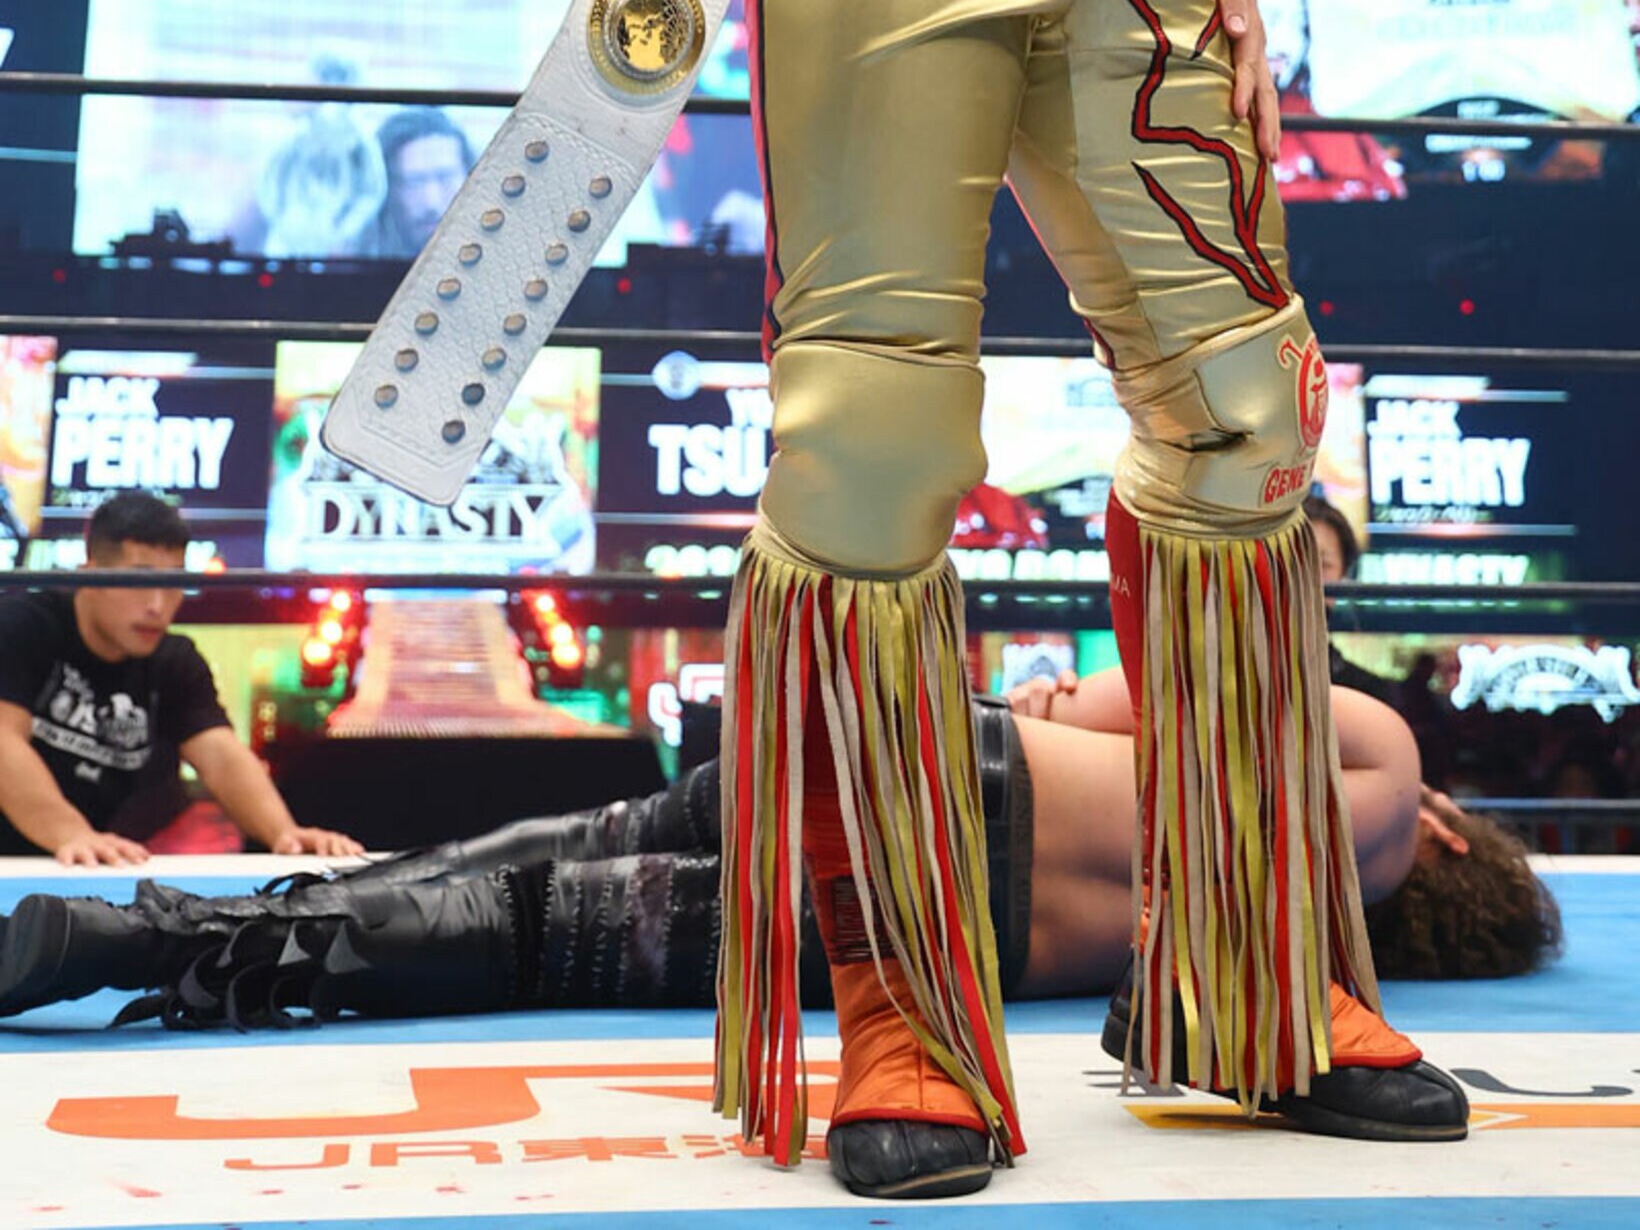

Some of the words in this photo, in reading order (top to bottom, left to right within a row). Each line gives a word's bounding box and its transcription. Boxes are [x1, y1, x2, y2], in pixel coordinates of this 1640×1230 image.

[56, 377, 159, 416] JACK
[1368, 400, 1461, 437] JACK
[52, 417, 233, 489] PERRY
[648, 423, 770, 497] TSU
[1370, 438, 1530, 505] PERRY
[1264, 467, 1305, 503] GENE
[315, 491, 548, 540] DYNASTY
